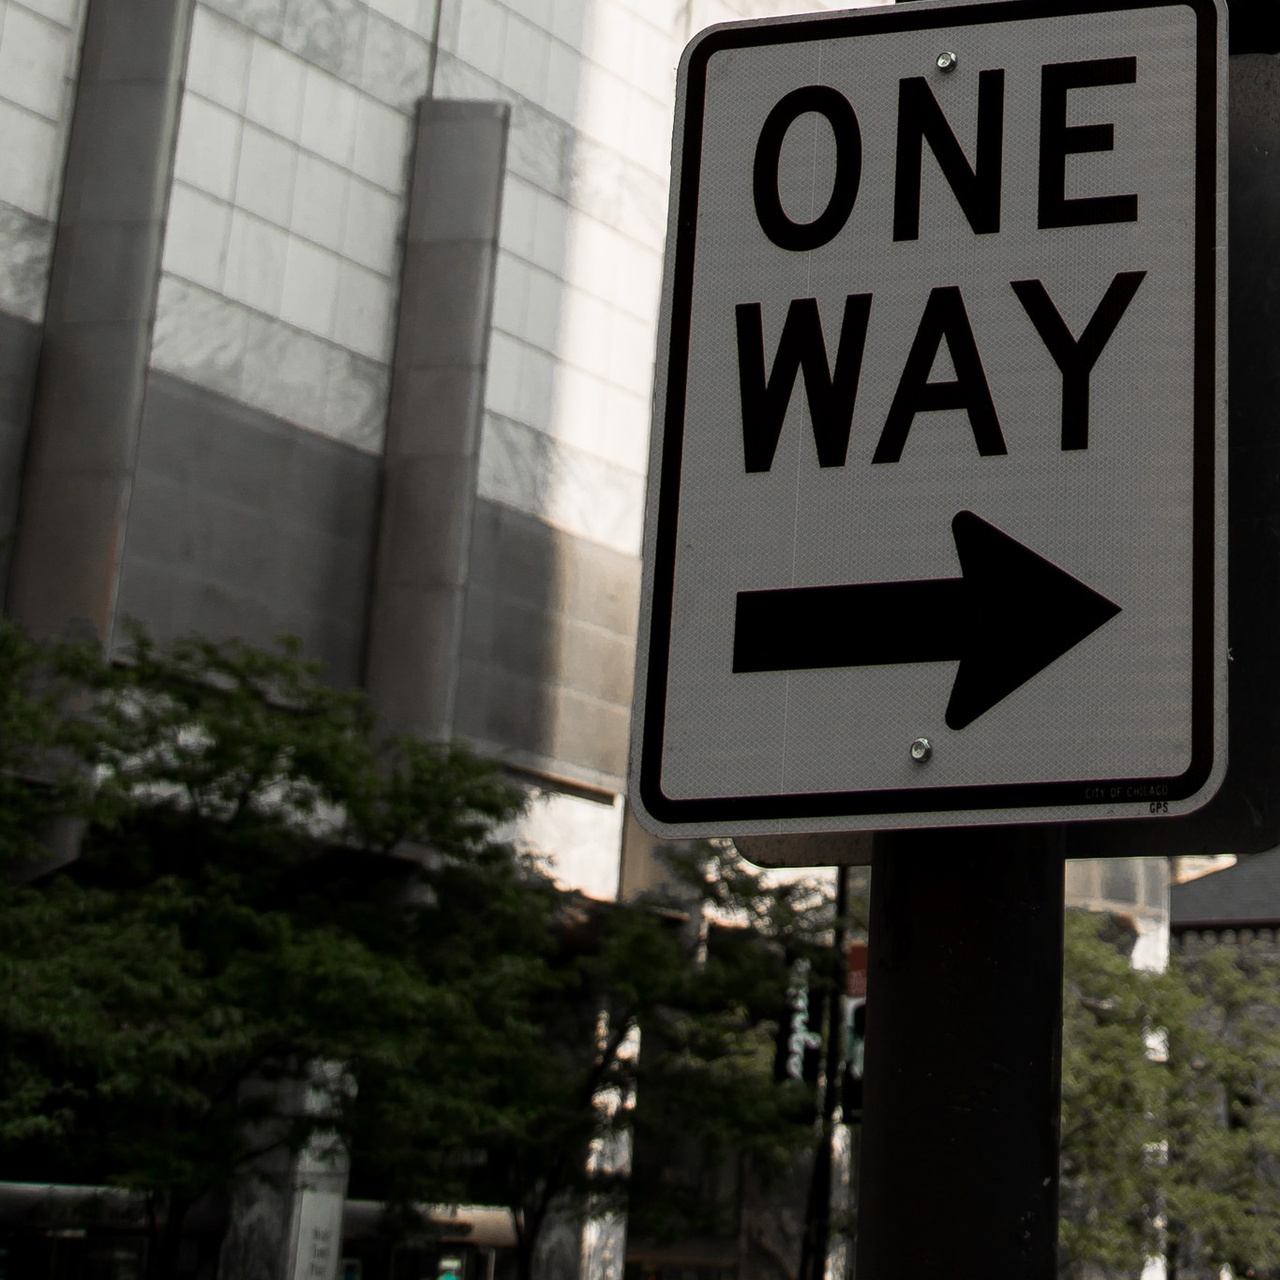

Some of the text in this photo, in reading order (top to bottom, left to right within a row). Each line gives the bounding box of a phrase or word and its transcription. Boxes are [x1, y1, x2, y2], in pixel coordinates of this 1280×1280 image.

[752, 55, 1139, 252] ONE
[735, 270, 1148, 473] WAY
[1149, 801, 1169, 814] GPS
